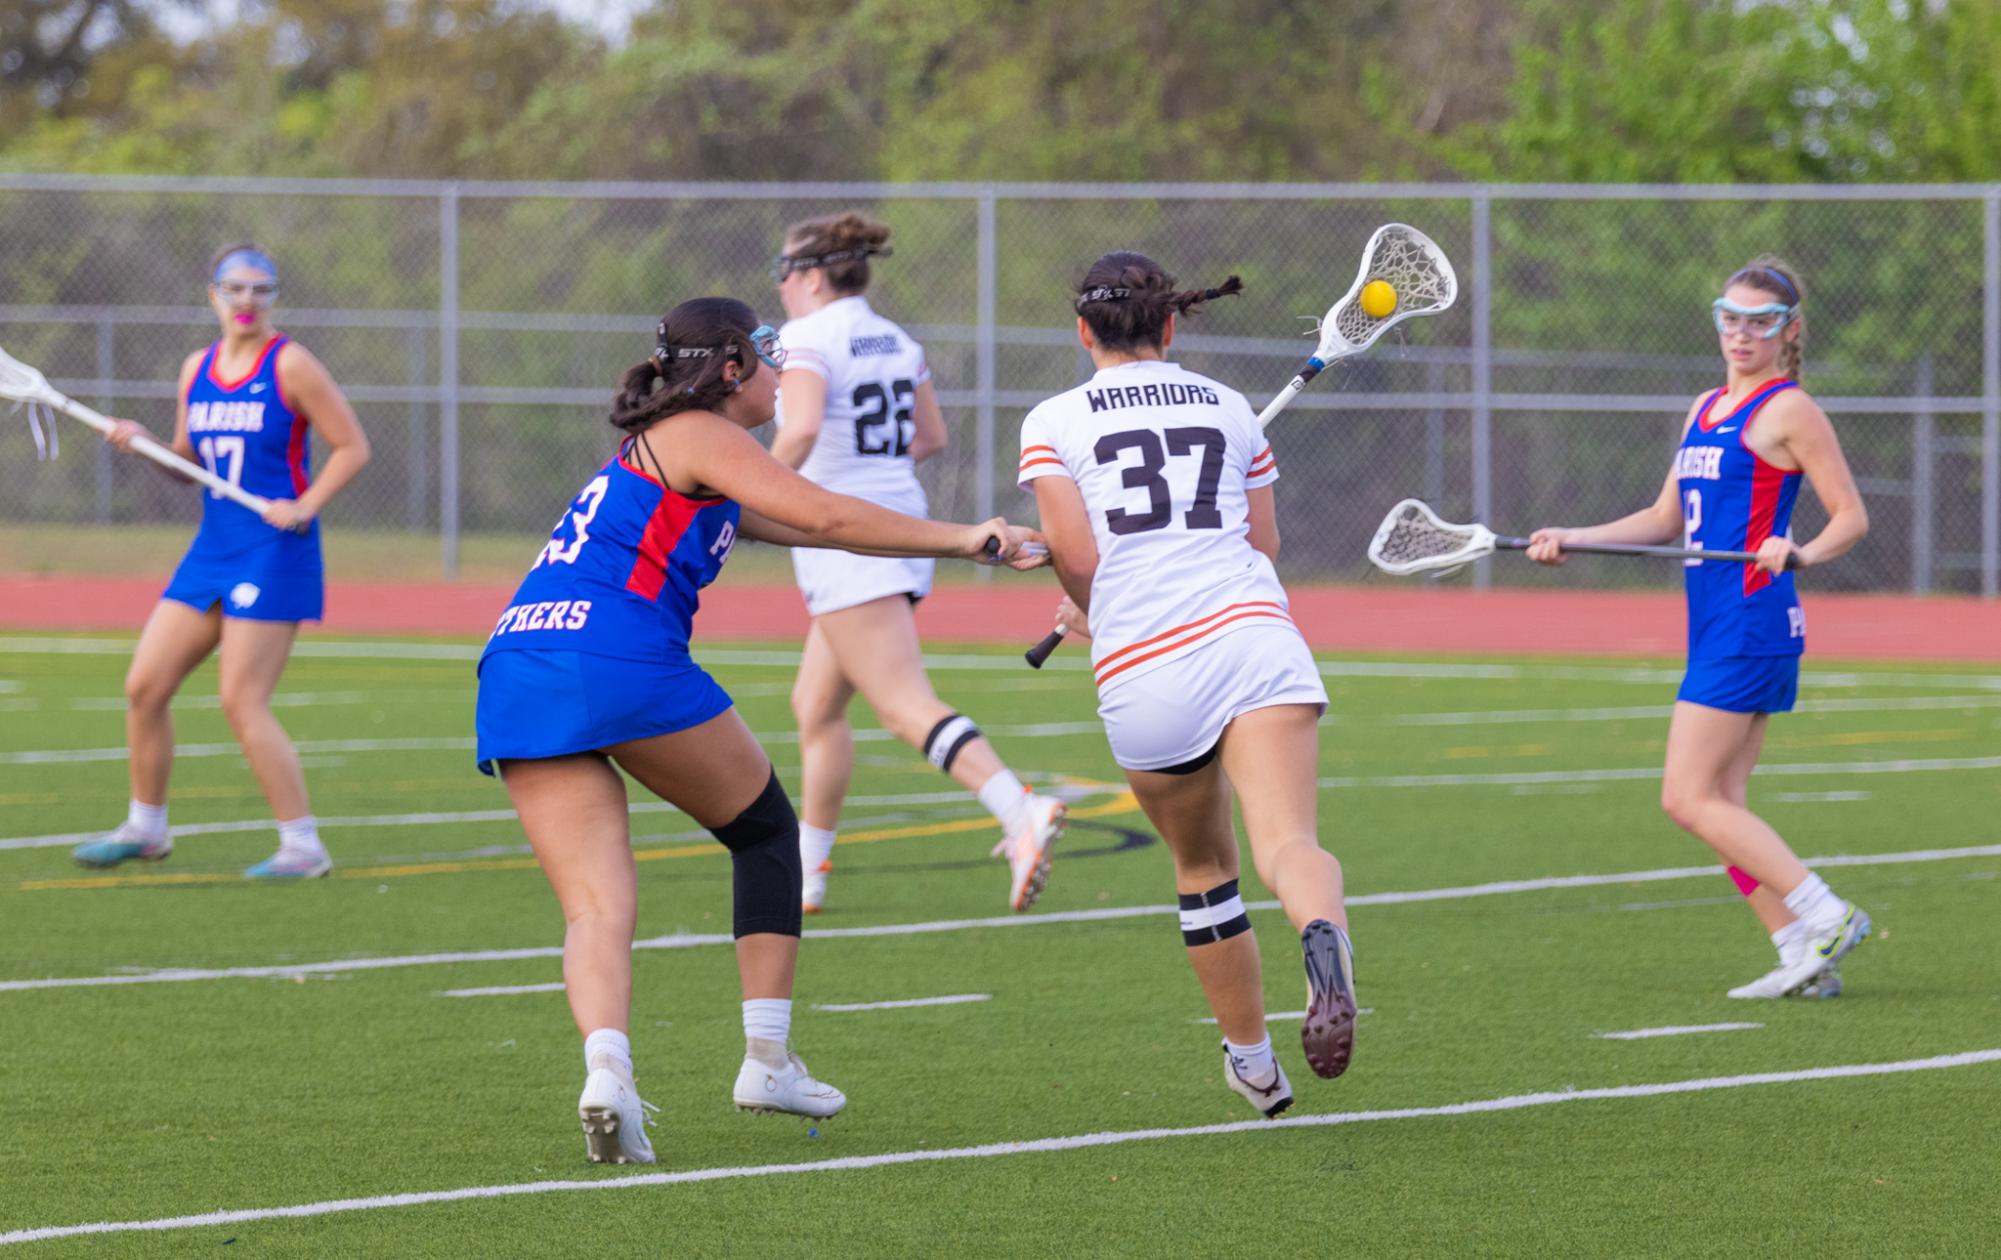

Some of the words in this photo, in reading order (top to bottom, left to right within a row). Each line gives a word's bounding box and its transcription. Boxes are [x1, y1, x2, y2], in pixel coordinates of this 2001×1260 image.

[678, 347, 714, 358] STX
[188, 401, 266, 432] PARISH
[1086, 383, 1220, 413] WARRIORS
[199, 436, 245, 499] 17
[1093, 426, 1227, 536] 37
[530, 474, 609, 571] 3
[488, 600, 592, 641] THERS
